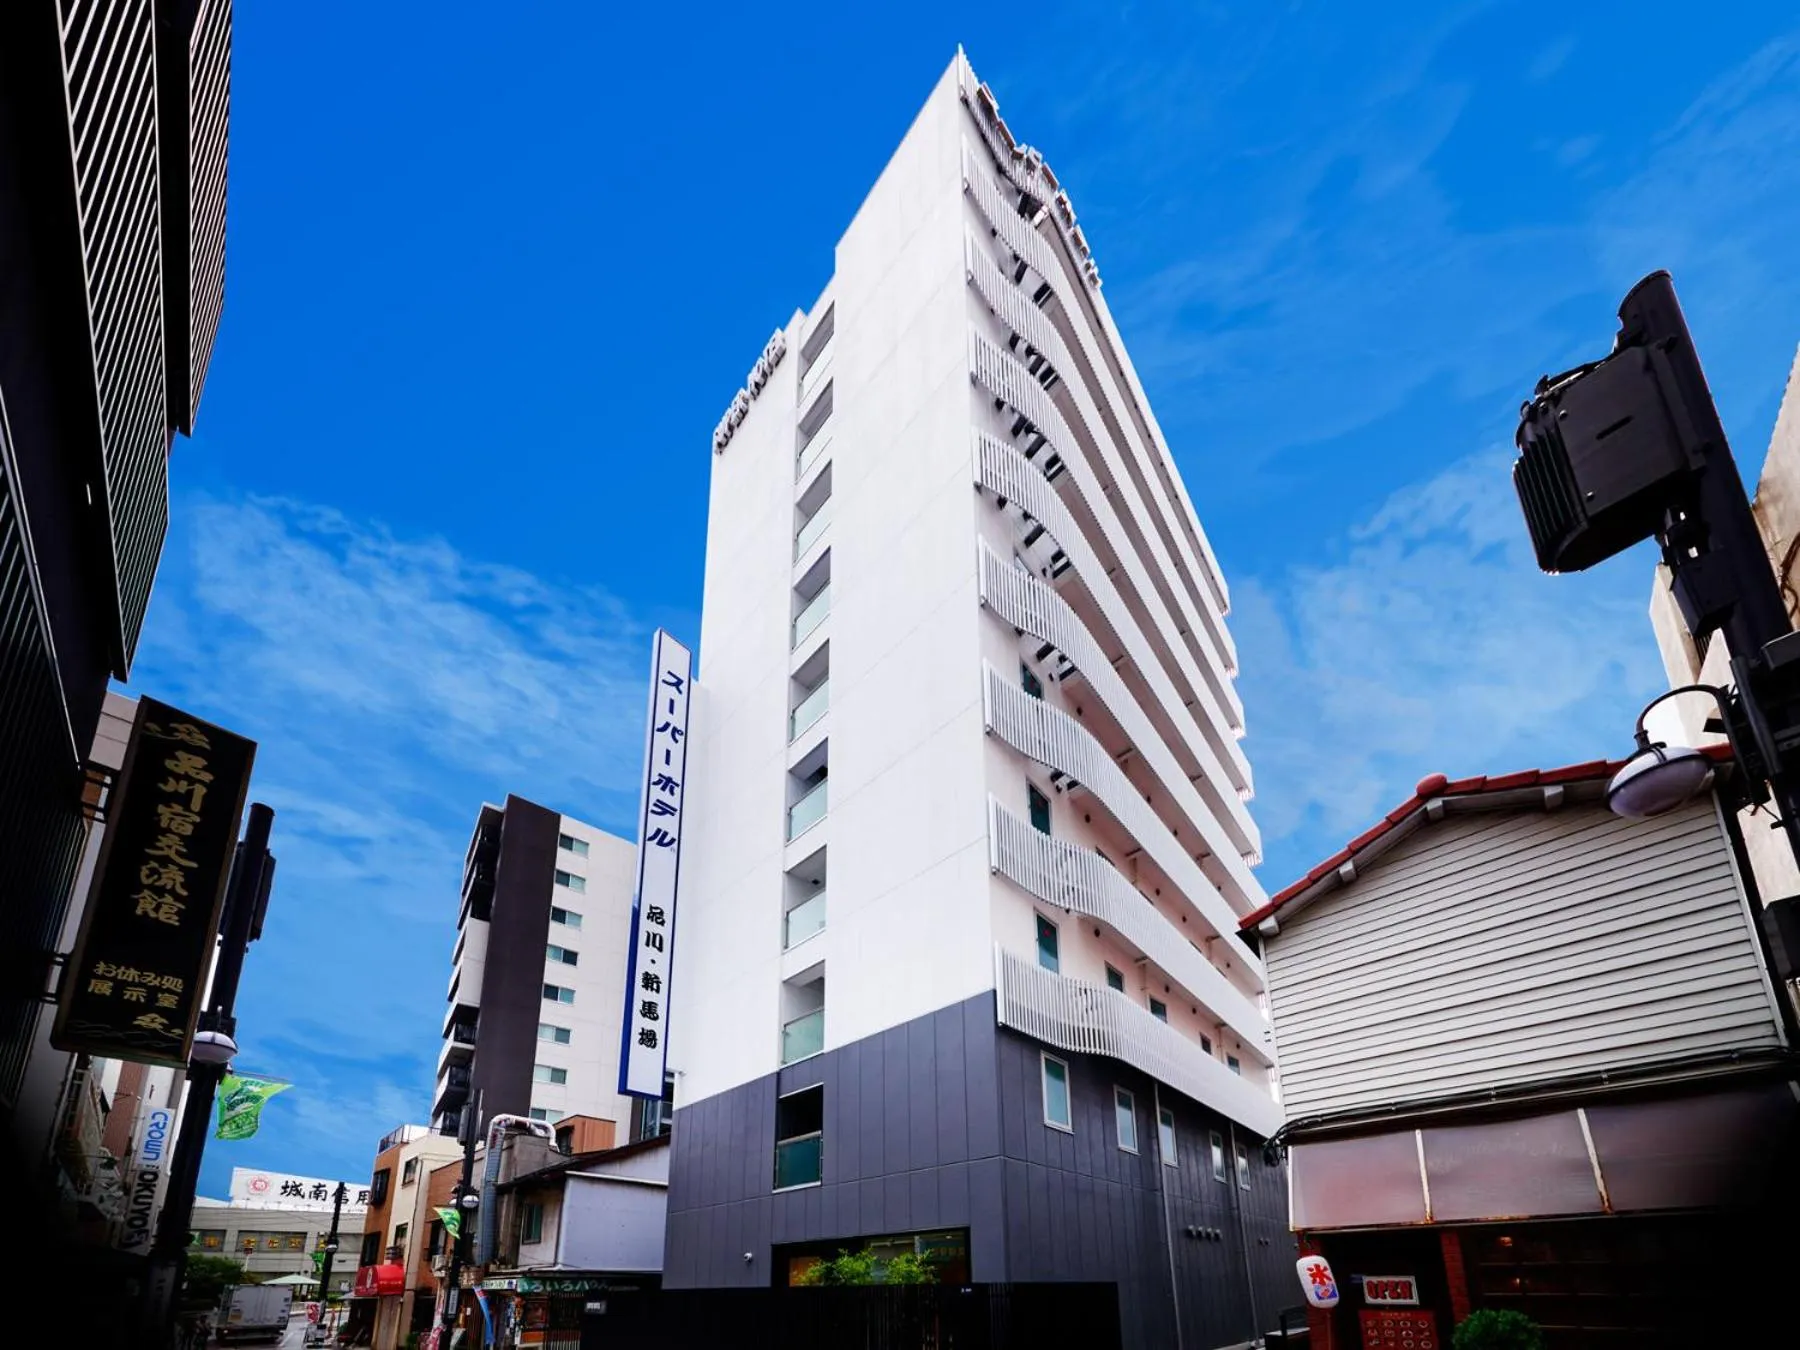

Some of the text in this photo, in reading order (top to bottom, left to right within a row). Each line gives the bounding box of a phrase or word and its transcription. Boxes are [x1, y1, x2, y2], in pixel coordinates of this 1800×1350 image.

[646, 670, 685, 848] スーパーホテル
[131, 750, 214, 926] 品川宿交流館
[88, 979, 179, 1008] 展示室
[93, 961, 184, 993] お休み処
[638, 904, 666, 1049] 品川・新馬場
[142, 1111, 168, 1162] CROWN
[1306, 1263, 1333, 1286] 氷
[1366, 1280, 1413, 1300] OPEN
